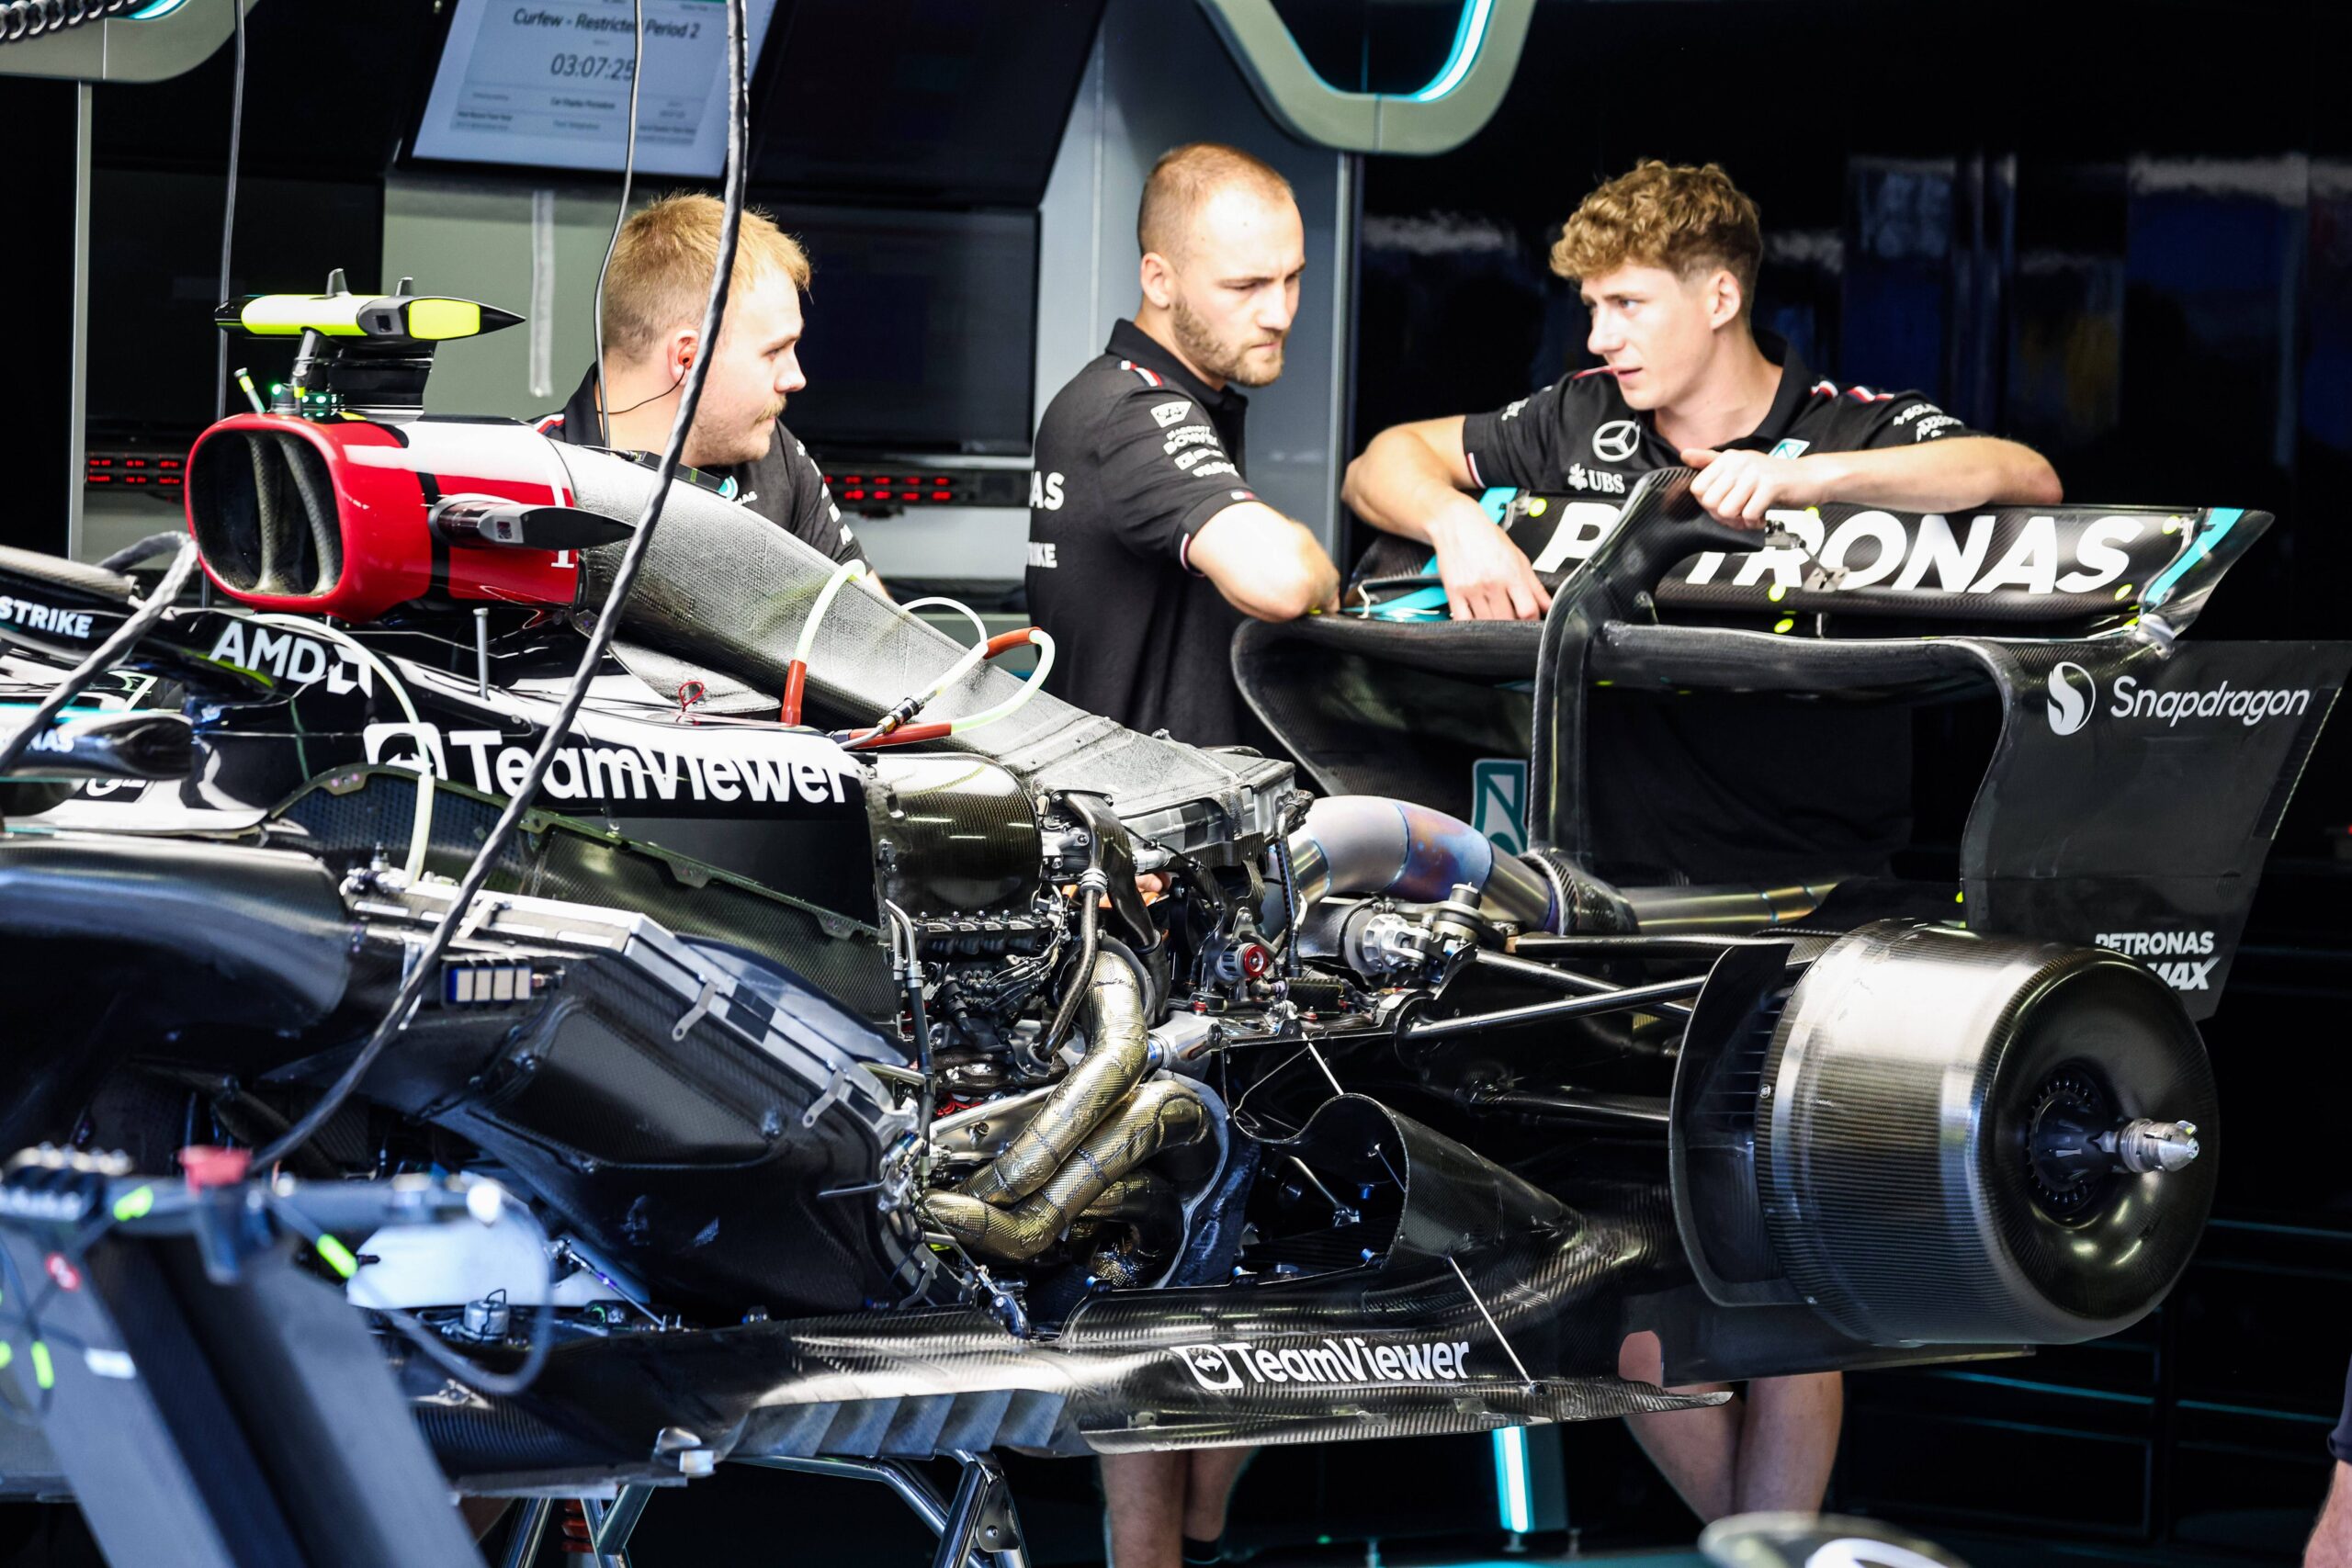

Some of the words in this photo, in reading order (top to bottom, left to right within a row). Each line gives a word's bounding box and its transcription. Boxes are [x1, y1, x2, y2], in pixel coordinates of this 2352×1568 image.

[514, 8, 563, 28] Curfew
[574, 13, 636, 33] Restricte
[645, 18, 688, 38] Period
[690, 23, 700, 39] 2
[1588, 469, 1625, 494] UBS
[1532, 502, 2145, 593] PRONAS
[209, 621, 327, 684] AMD
[2110, 675, 2310, 728] Snapdragon
[448, 730, 846, 804] TeamViewer
[1220, 1337, 1470, 1383] TeamViewer
